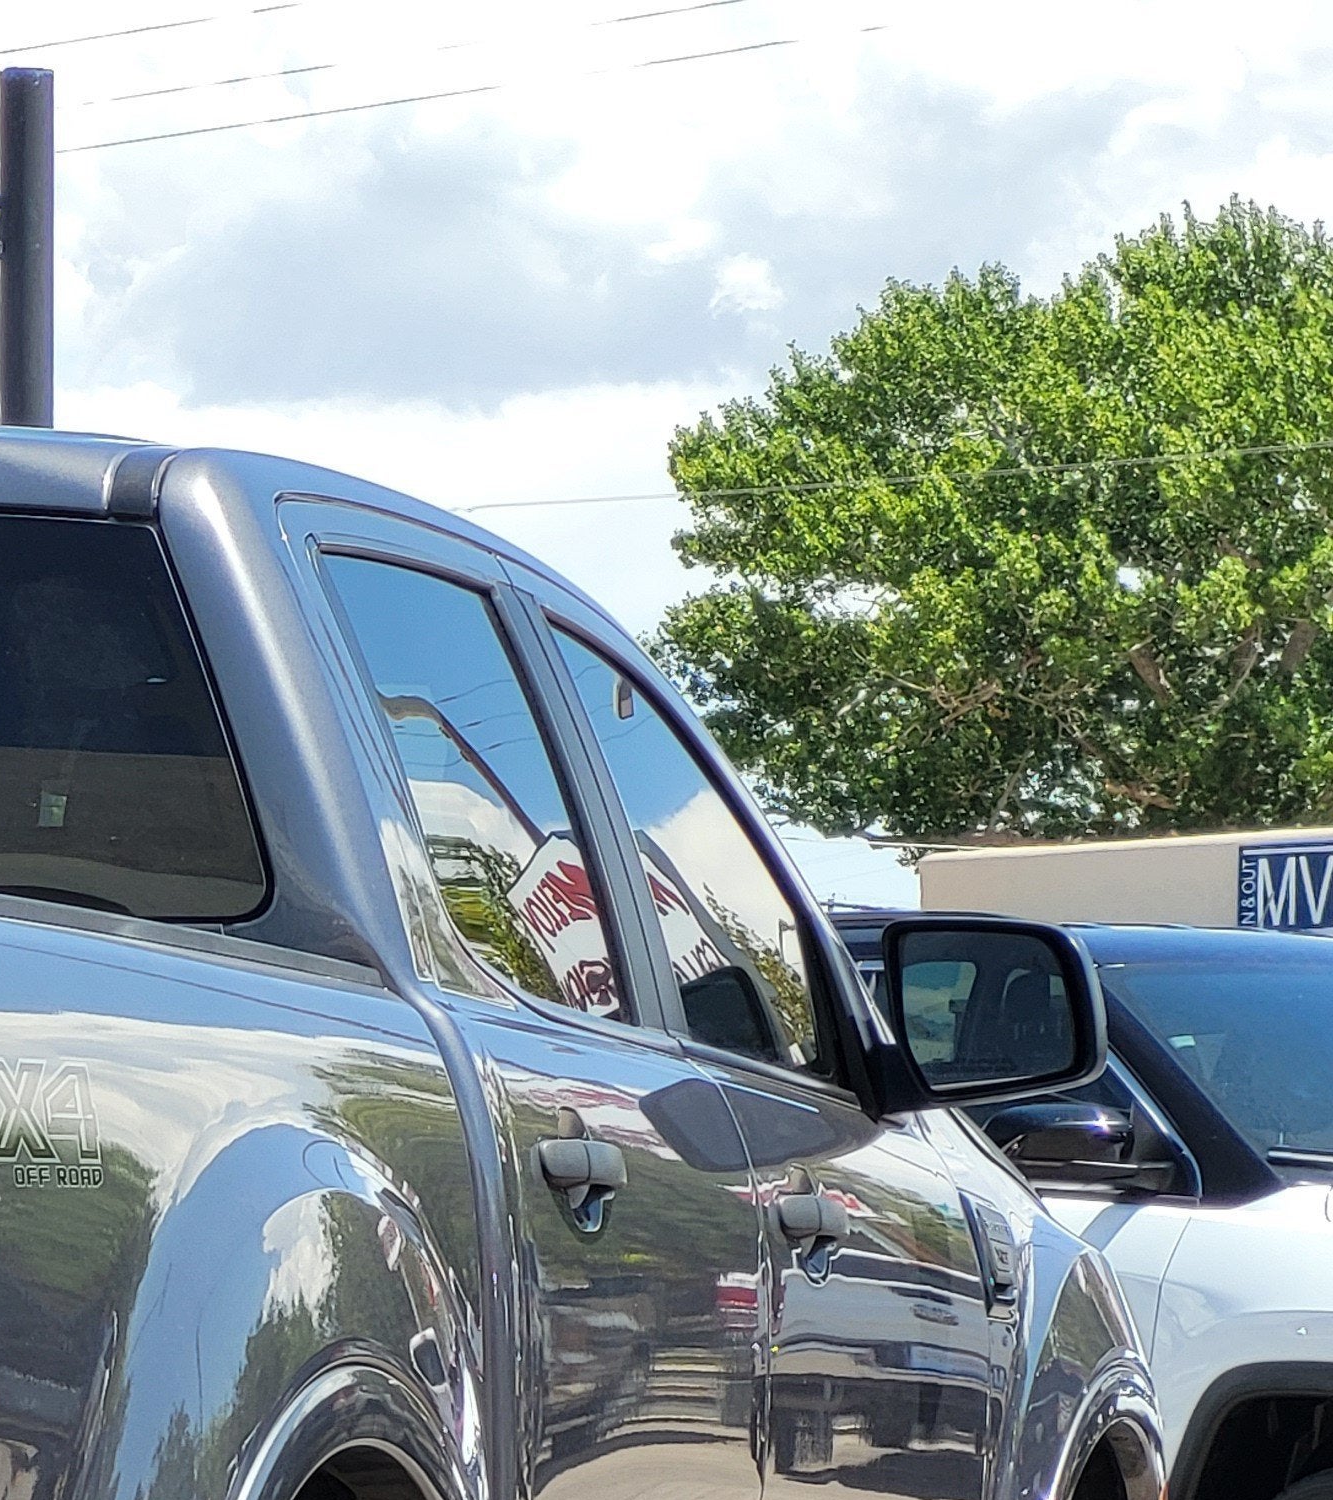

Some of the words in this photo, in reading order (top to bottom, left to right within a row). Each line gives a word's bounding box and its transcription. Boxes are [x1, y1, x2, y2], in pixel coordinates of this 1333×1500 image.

[1241, 859, 1257, 894] OUT
[14, 1165, 51, 1188] OFF
[55, 1165, 103, 1188] ROAD
